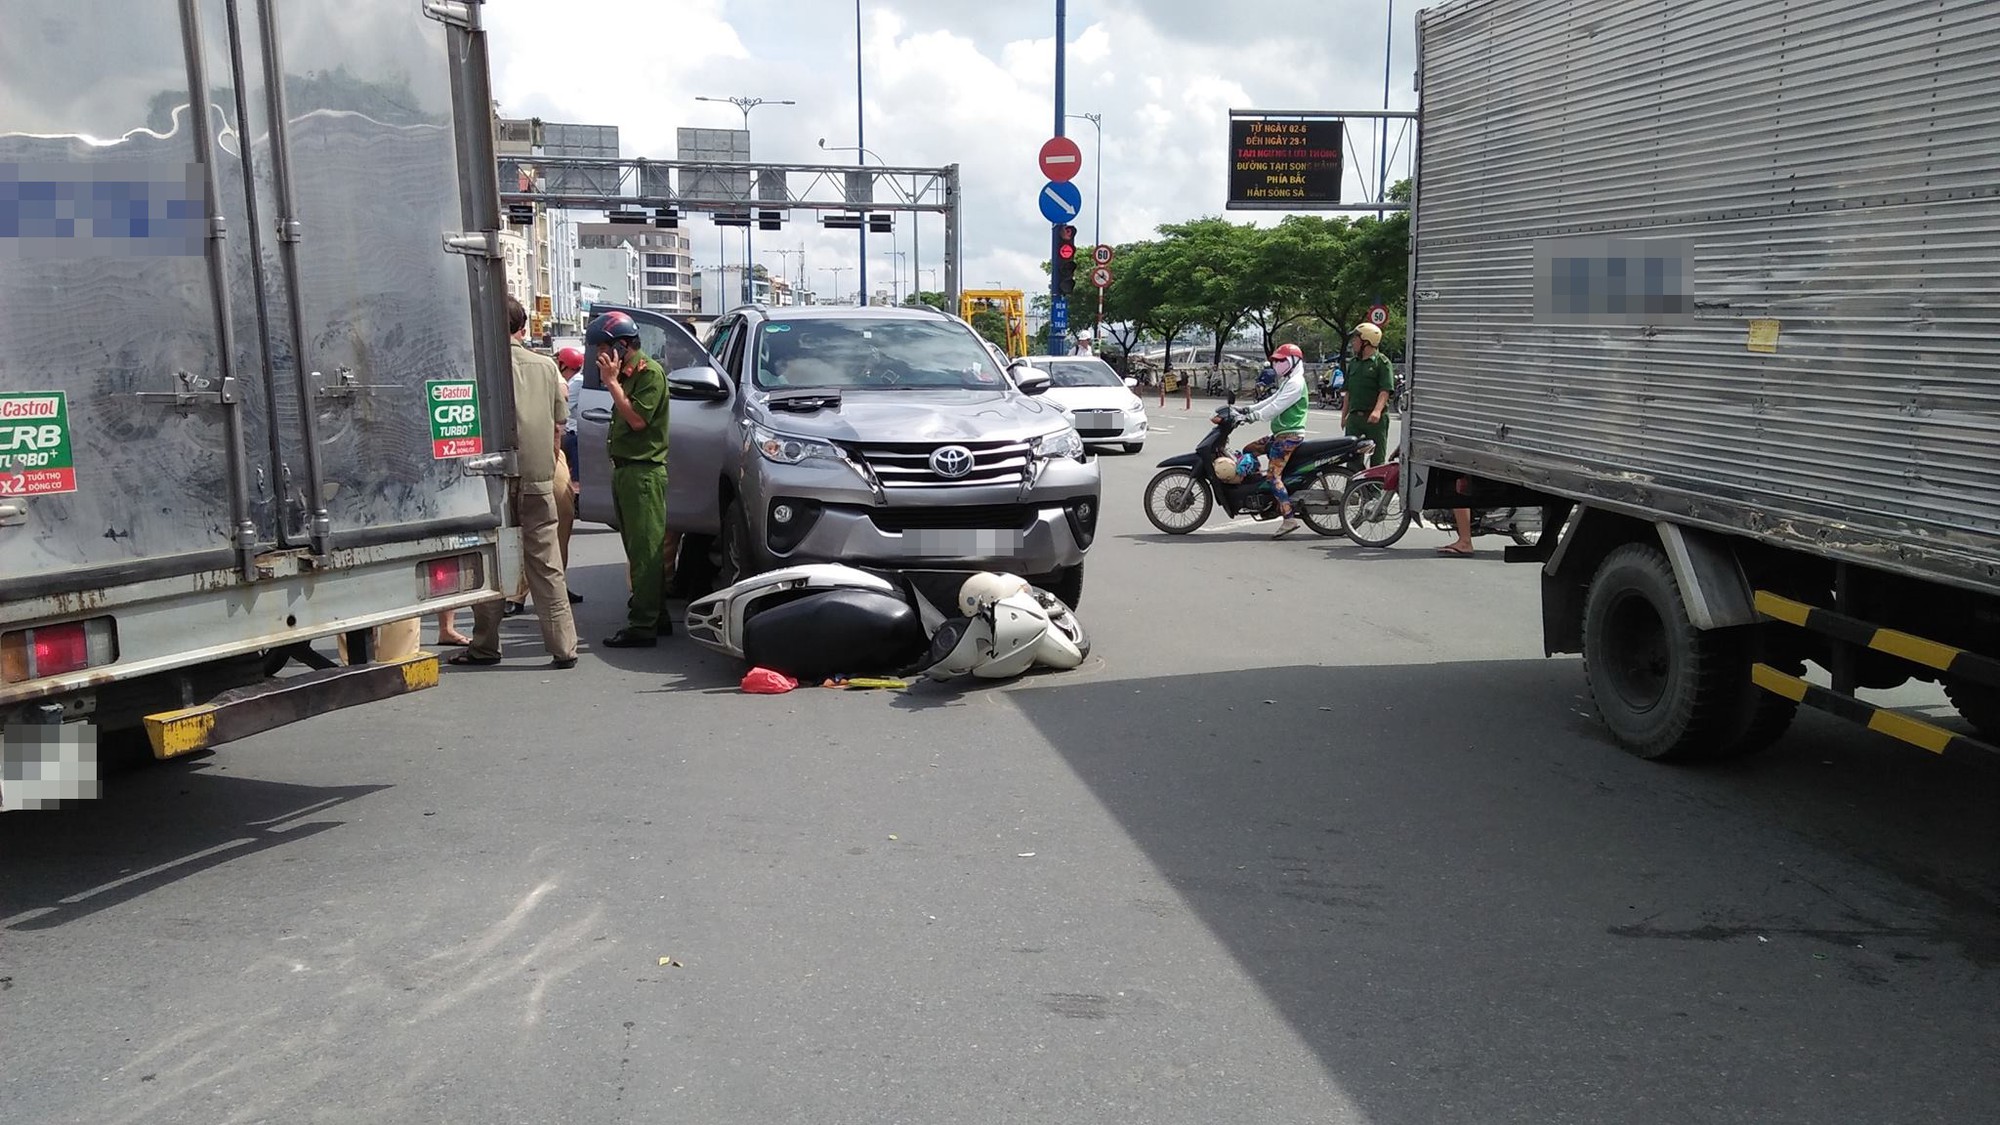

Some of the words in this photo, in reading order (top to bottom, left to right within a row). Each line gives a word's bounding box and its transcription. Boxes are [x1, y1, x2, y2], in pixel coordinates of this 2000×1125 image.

[1264, 122, 1287, 133] NGÀY
[1265, 134, 1287, 145] NGÀY
[1237, 160, 1268, 171] ĐƯỜNG
[1269, 162, 1288, 172] TẠM
[1266, 172, 1288, 184] PHÍA
[1098, 250, 1108, 260] 60
[1374, 312, 1384, 321] 50
[442, 387, 470, 399] Castrol
[3, 401, 54, 417] Castrol
[434, 405, 475, 423] CRB
[443, 440, 457, 456] x2
[46, 472, 61, 481] THỌ
[0, 473, 27, 494] x2
[28, 482, 51, 492] ĐỘNG
[51, 481, 62, 489] CƠ
